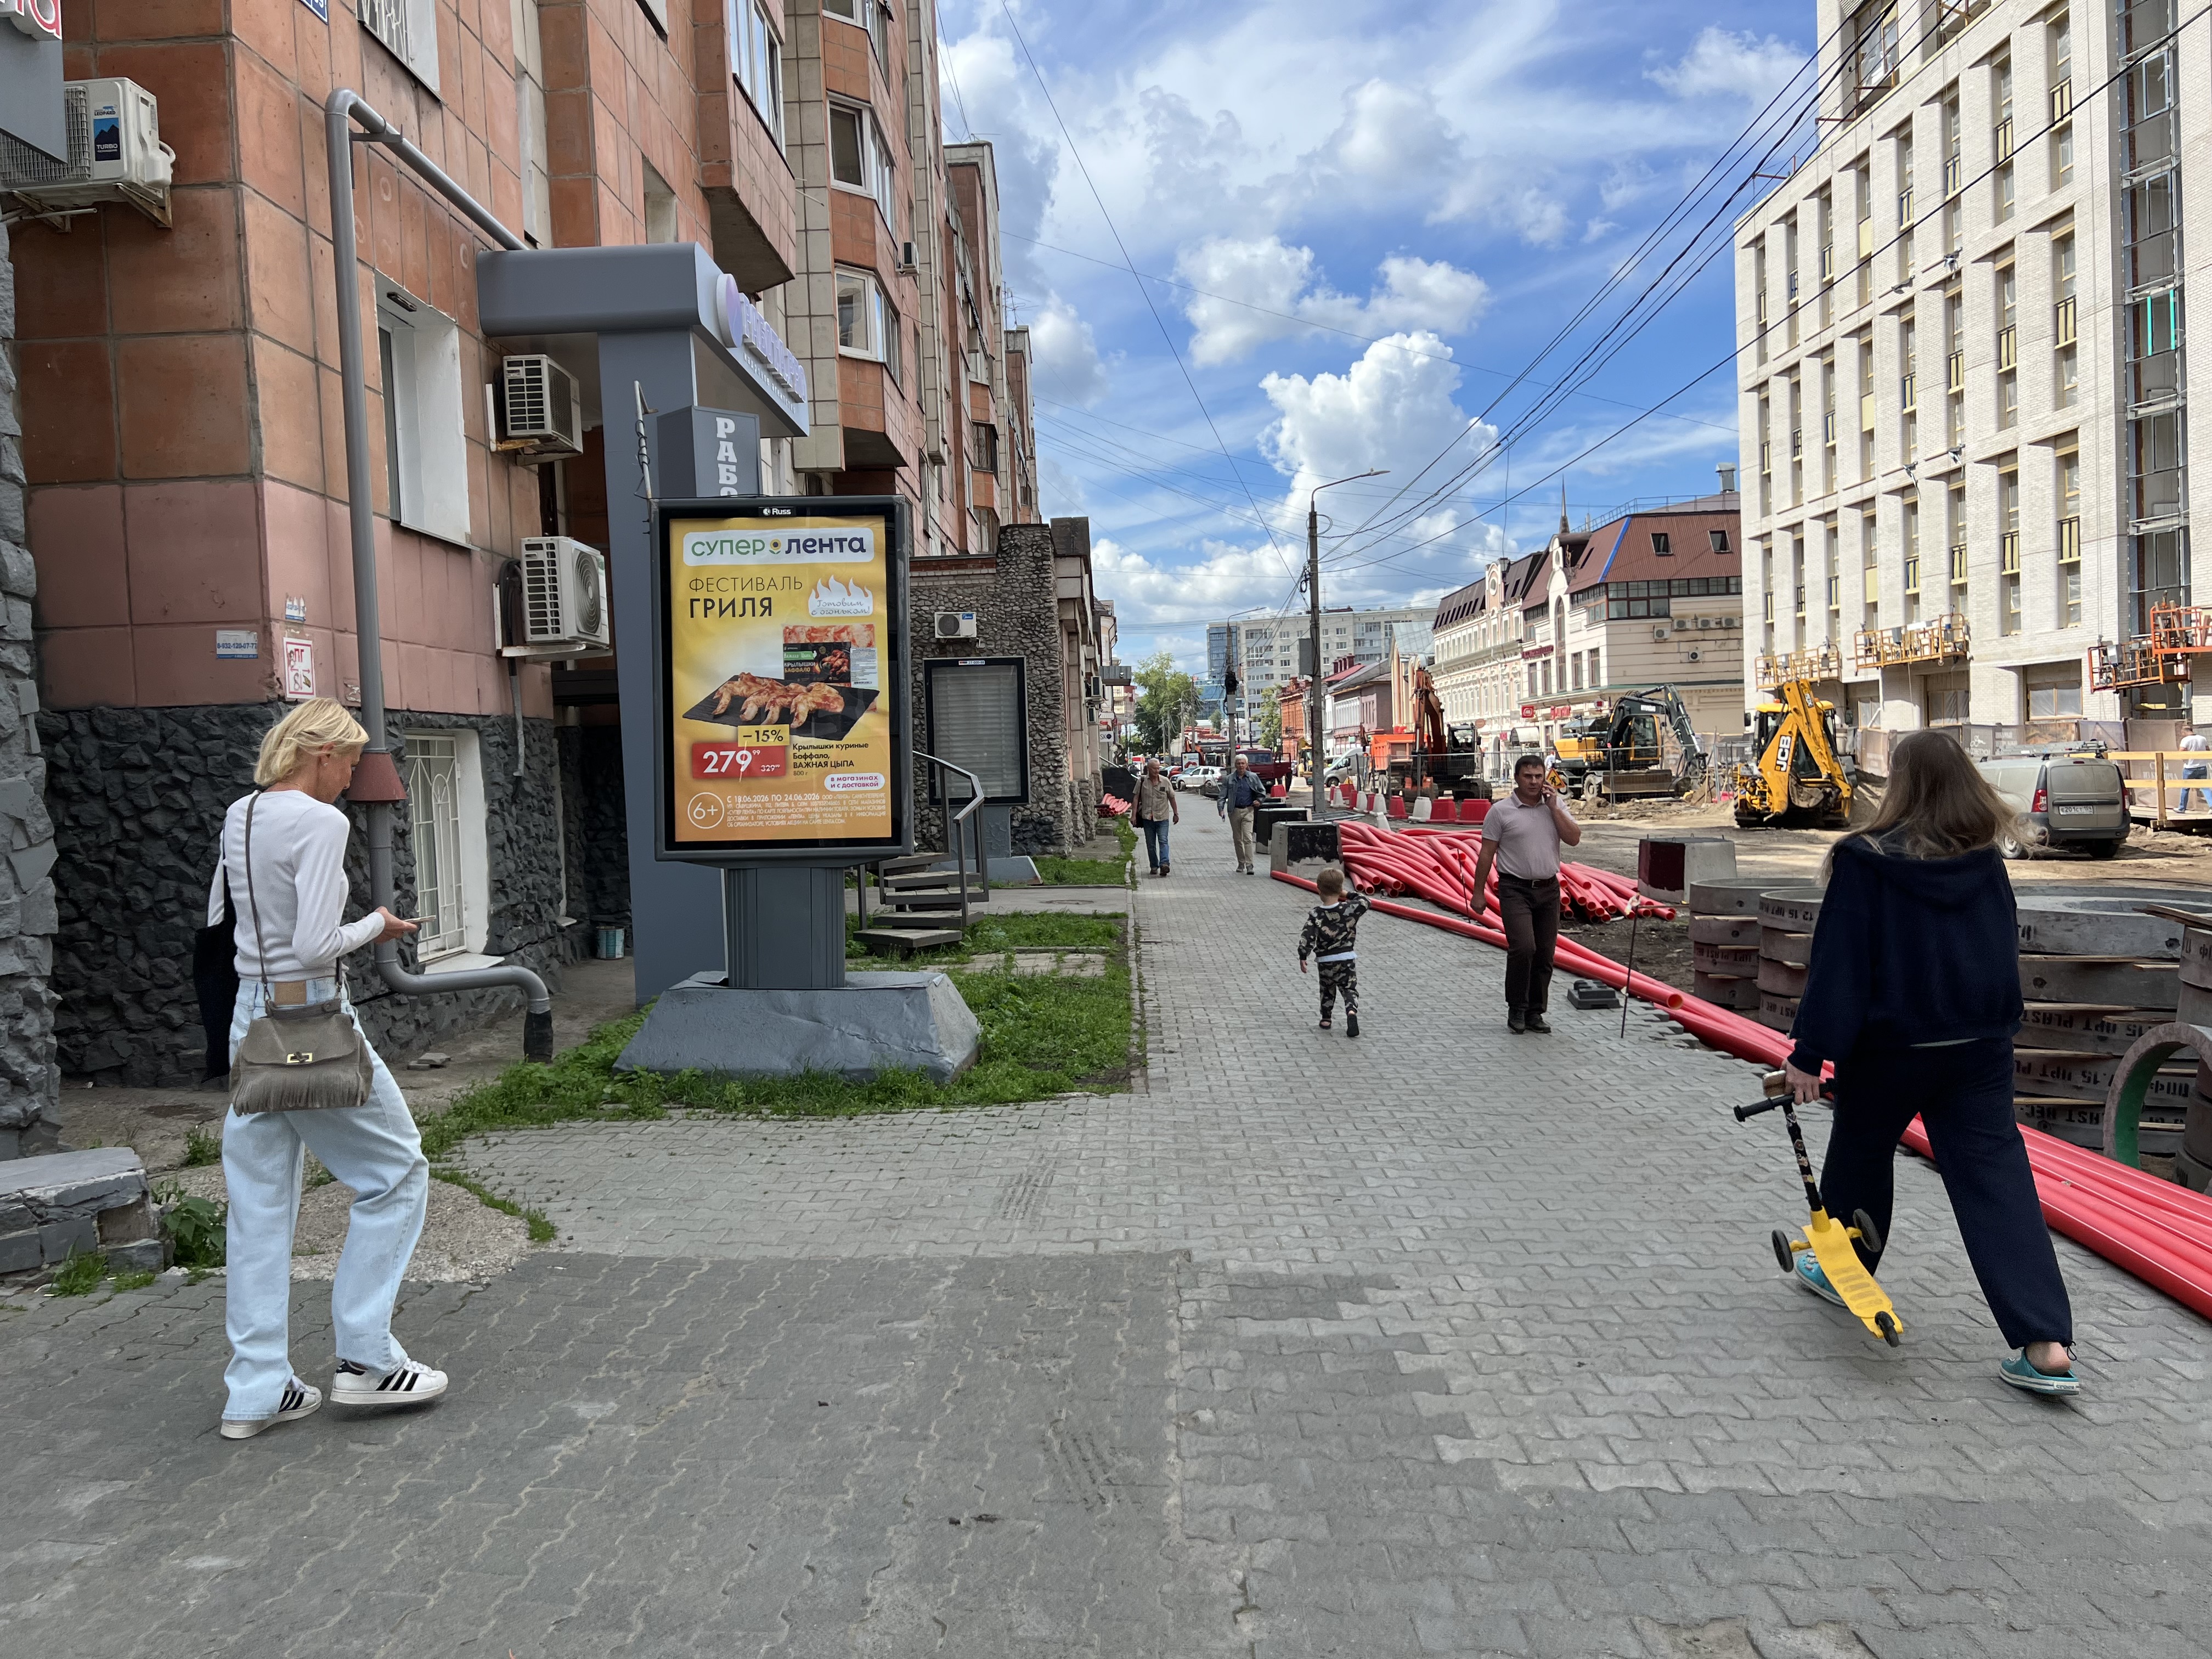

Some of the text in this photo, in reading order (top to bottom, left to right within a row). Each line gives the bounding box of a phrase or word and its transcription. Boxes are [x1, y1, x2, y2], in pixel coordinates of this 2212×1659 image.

[744, 353, 795, 414] кадровое агентство
[691, 537, 867, 557] супер лента
[689, 576, 803, 592] ФЕСТИВАЛЬ
[690, 597, 772, 618] ГРИЛЯ
[817, 598, 864, 607] Готовим
[820, 606, 870, 615] огоньком!
[743, 730, 784, 743] -15%
[702, 750, 753, 774] 279
[793, 752, 830, 760] Баффало,
[1776, 736, 1791, 771] JCB
[831, 760, 855, 769] ЦЫПА
[693, 802, 718, 820] 6+
